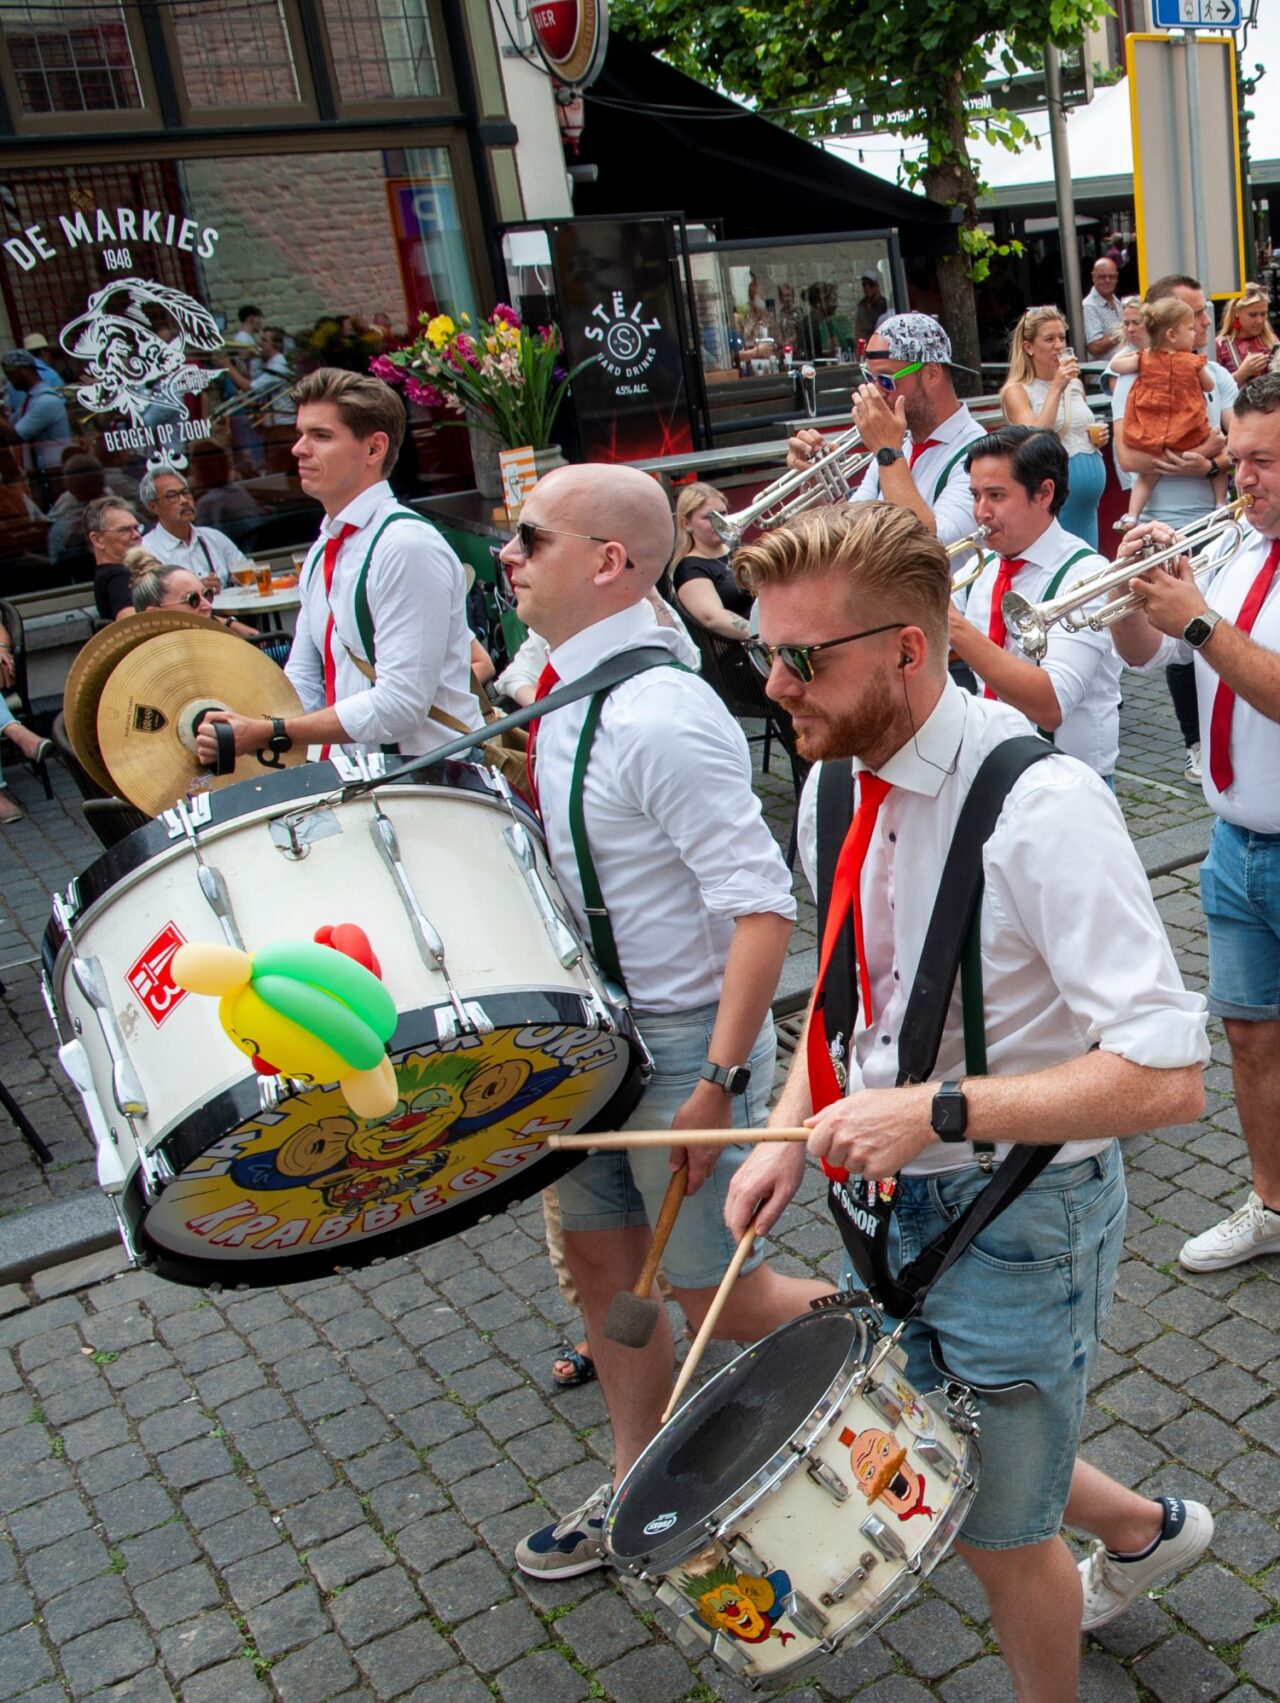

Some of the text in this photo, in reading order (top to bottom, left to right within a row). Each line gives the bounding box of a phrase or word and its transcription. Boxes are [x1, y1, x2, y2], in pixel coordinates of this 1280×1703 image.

[534, 9, 556, 29] BIER
[4, 208, 219, 271] DE MARKIES
[103, 248, 132, 270] 1948
[584, 290, 661, 342] STËLZ
[626, 347, 656, 377] DRINKS
[104, 418, 212, 452] BERGEN OP ZOOM
[186, 1116, 571, 1249] KRABBEGAT
